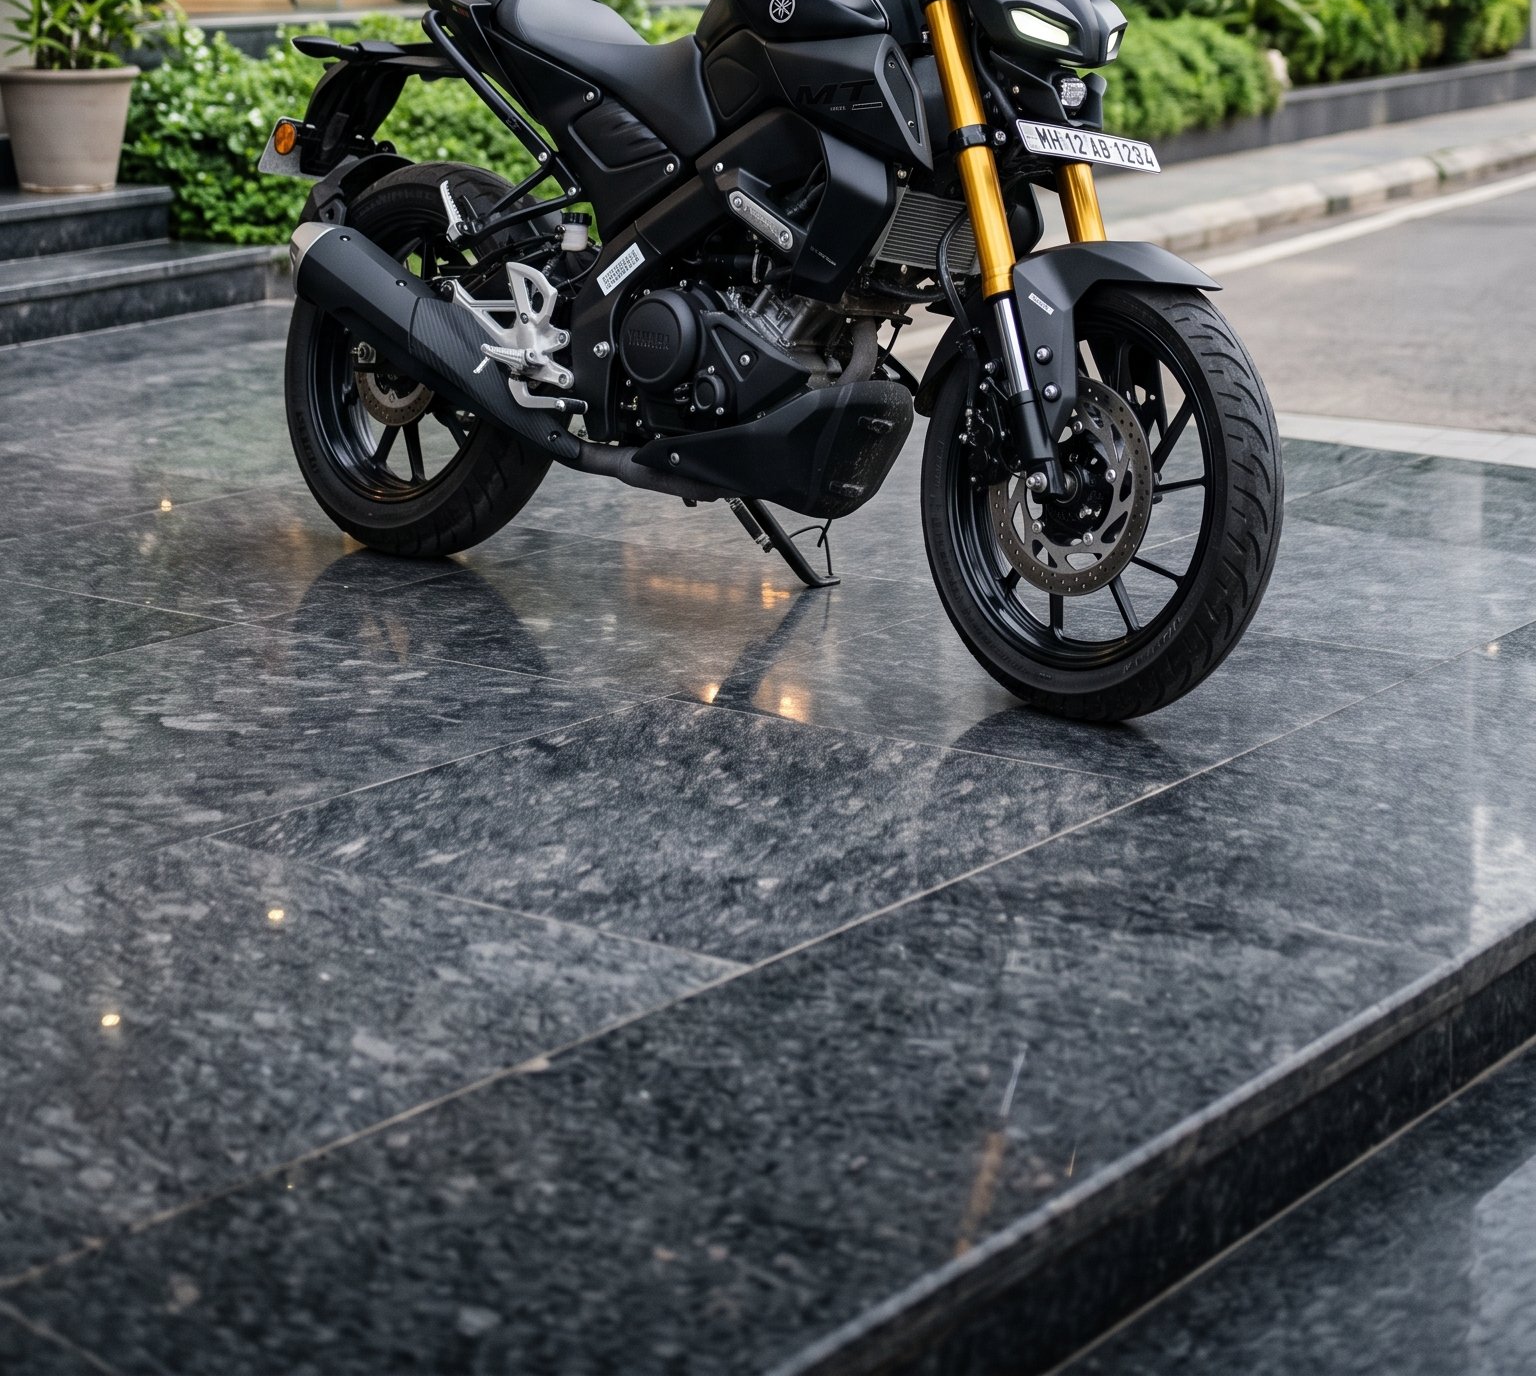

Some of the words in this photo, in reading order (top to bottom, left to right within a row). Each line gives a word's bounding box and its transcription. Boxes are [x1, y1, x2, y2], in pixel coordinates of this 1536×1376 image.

[796, 79, 875, 104] MT
[1035, 126, 1063, 151] MH
[1065, 133, 1087, 155] 12
[1090, 137, 1111, 159] AB
[1114, 141, 1154, 167] 1234
